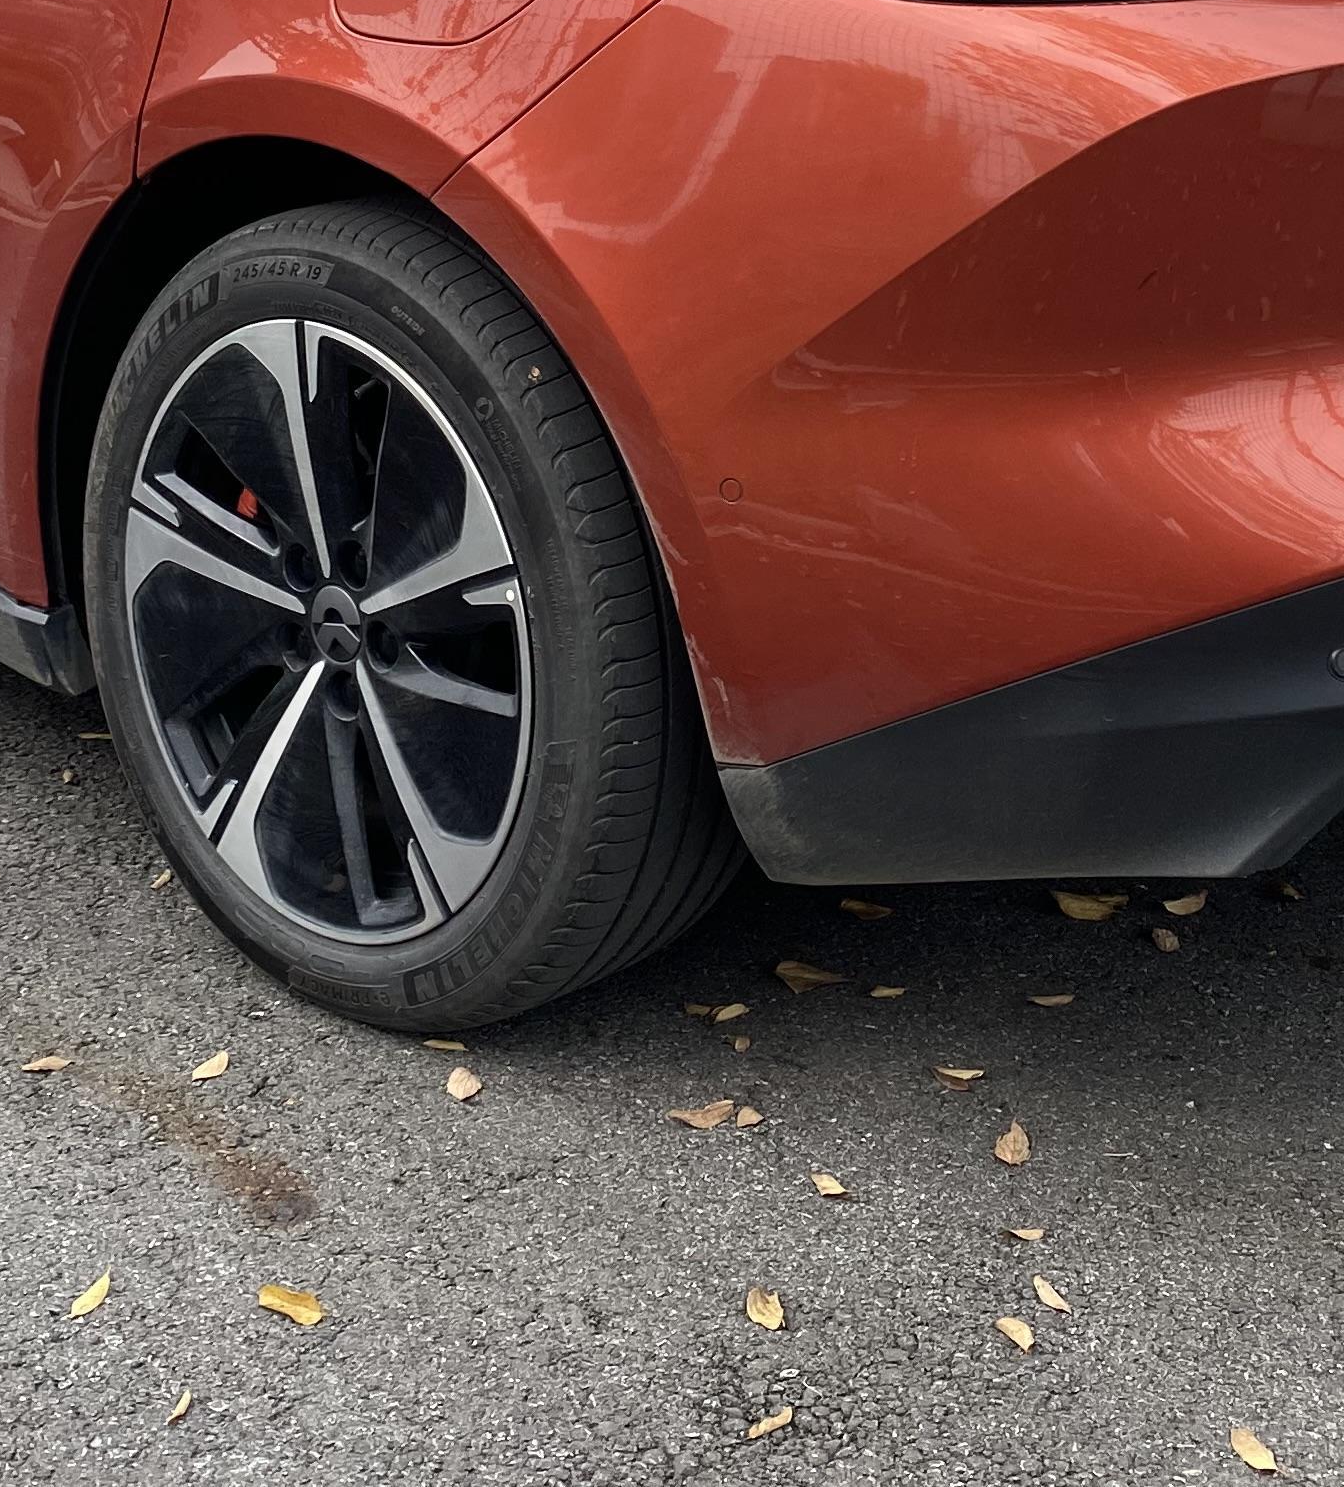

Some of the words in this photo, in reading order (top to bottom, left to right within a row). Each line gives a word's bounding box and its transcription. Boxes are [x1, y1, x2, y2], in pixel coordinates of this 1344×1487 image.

[233, 261, 287, 283] 245/45
[289, 262, 301, 278] R
[305, 264, 322, 280] 19
[391, 305, 426, 336] OUTSIDE
[413, 829, 556, 1002] MICHELIN
